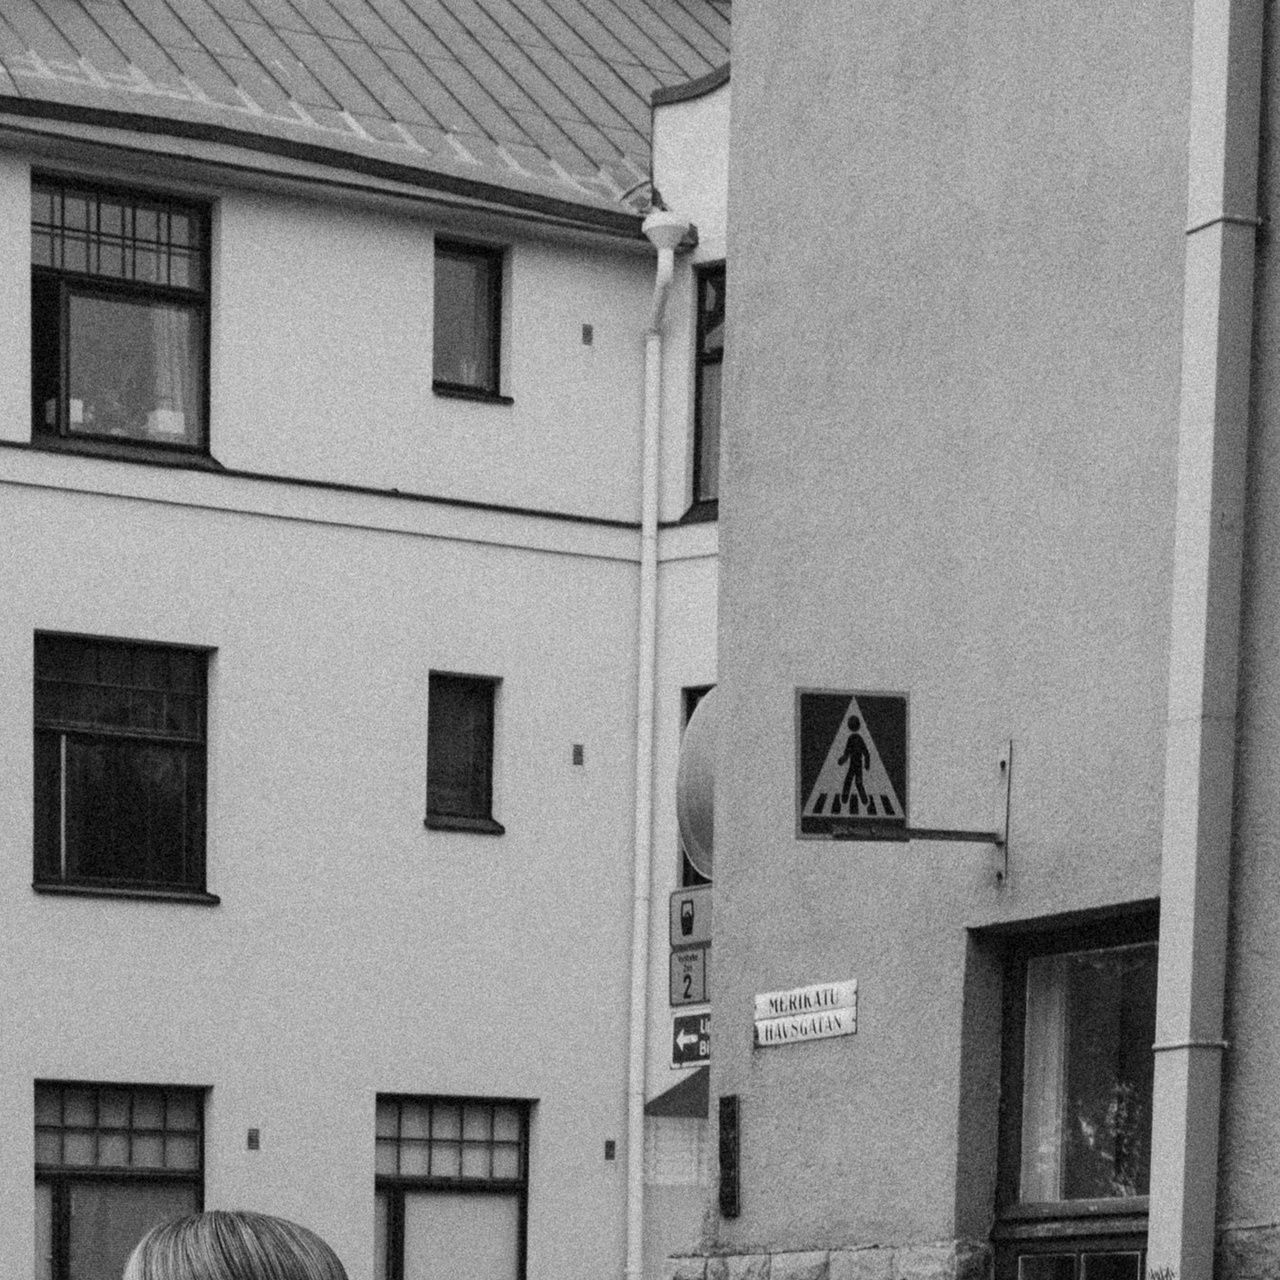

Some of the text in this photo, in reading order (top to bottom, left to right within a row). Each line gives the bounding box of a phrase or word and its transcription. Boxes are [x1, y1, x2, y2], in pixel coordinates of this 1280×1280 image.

[683, 974, 692, 999] 2
[769, 988, 839, 1014] MERIKATU
[765, 1015, 842, 1041] HAVSGATAN
